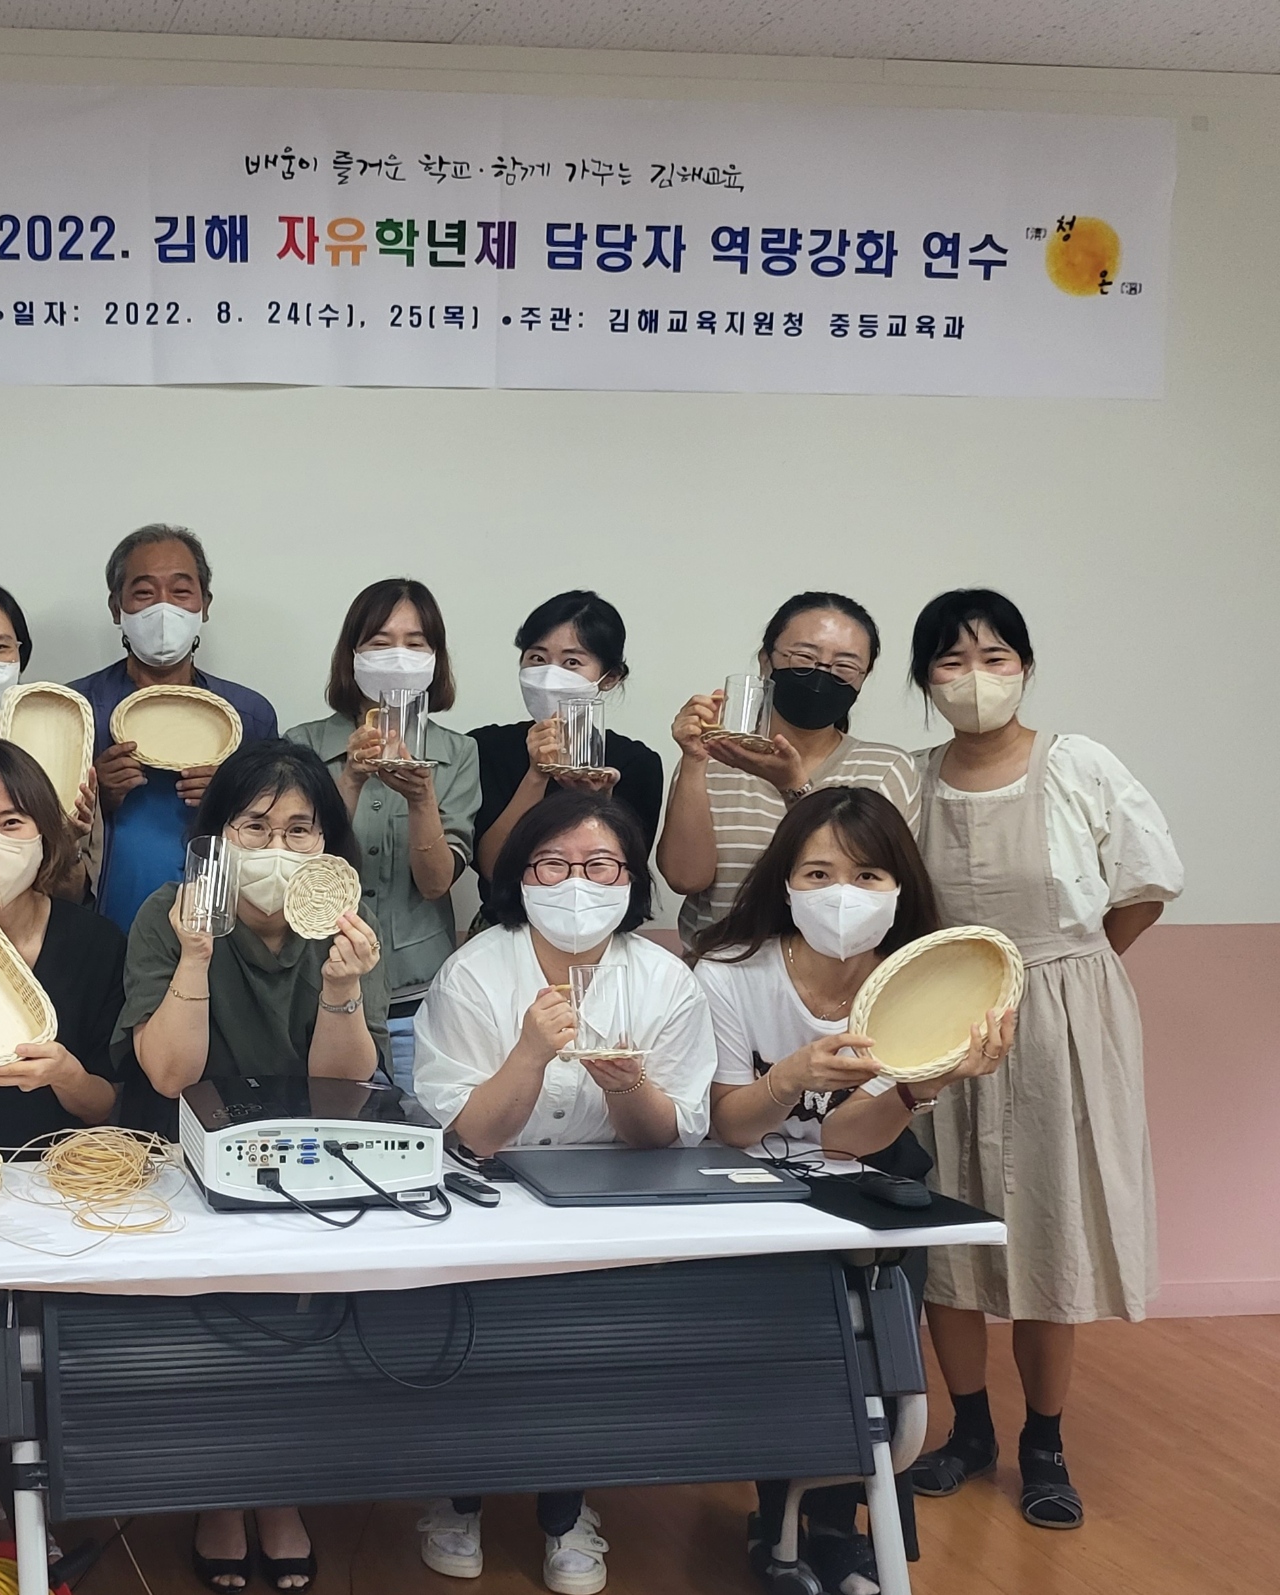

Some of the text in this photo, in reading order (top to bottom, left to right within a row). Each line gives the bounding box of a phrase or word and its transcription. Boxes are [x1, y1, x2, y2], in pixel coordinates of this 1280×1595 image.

[244, 145, 318, 181] 배움이
[332, 149, 407, 186] 즐거운
[564, 158, 632, 187] 가꾸는
[650, 162, 745, 193] 김해교육
[153, 214, 250, 265] 김해
[276, 215, 518, 270] 자유학년제
[544, 222, 687, 274] 담당자
[710, 225, 899, 280] 역량강화
[922, 231, 1009, 282] 연수
[104, 301, 192, 326] 2022.
[216, 300, 243, 325] 8.
[267, 300, 366, 330] 24(수),
[389, 304, 479, 331] 25(목)
[608, 308, 804, 338] 김해교육지원청
[829, 313, 965, 341] 중등교육과
